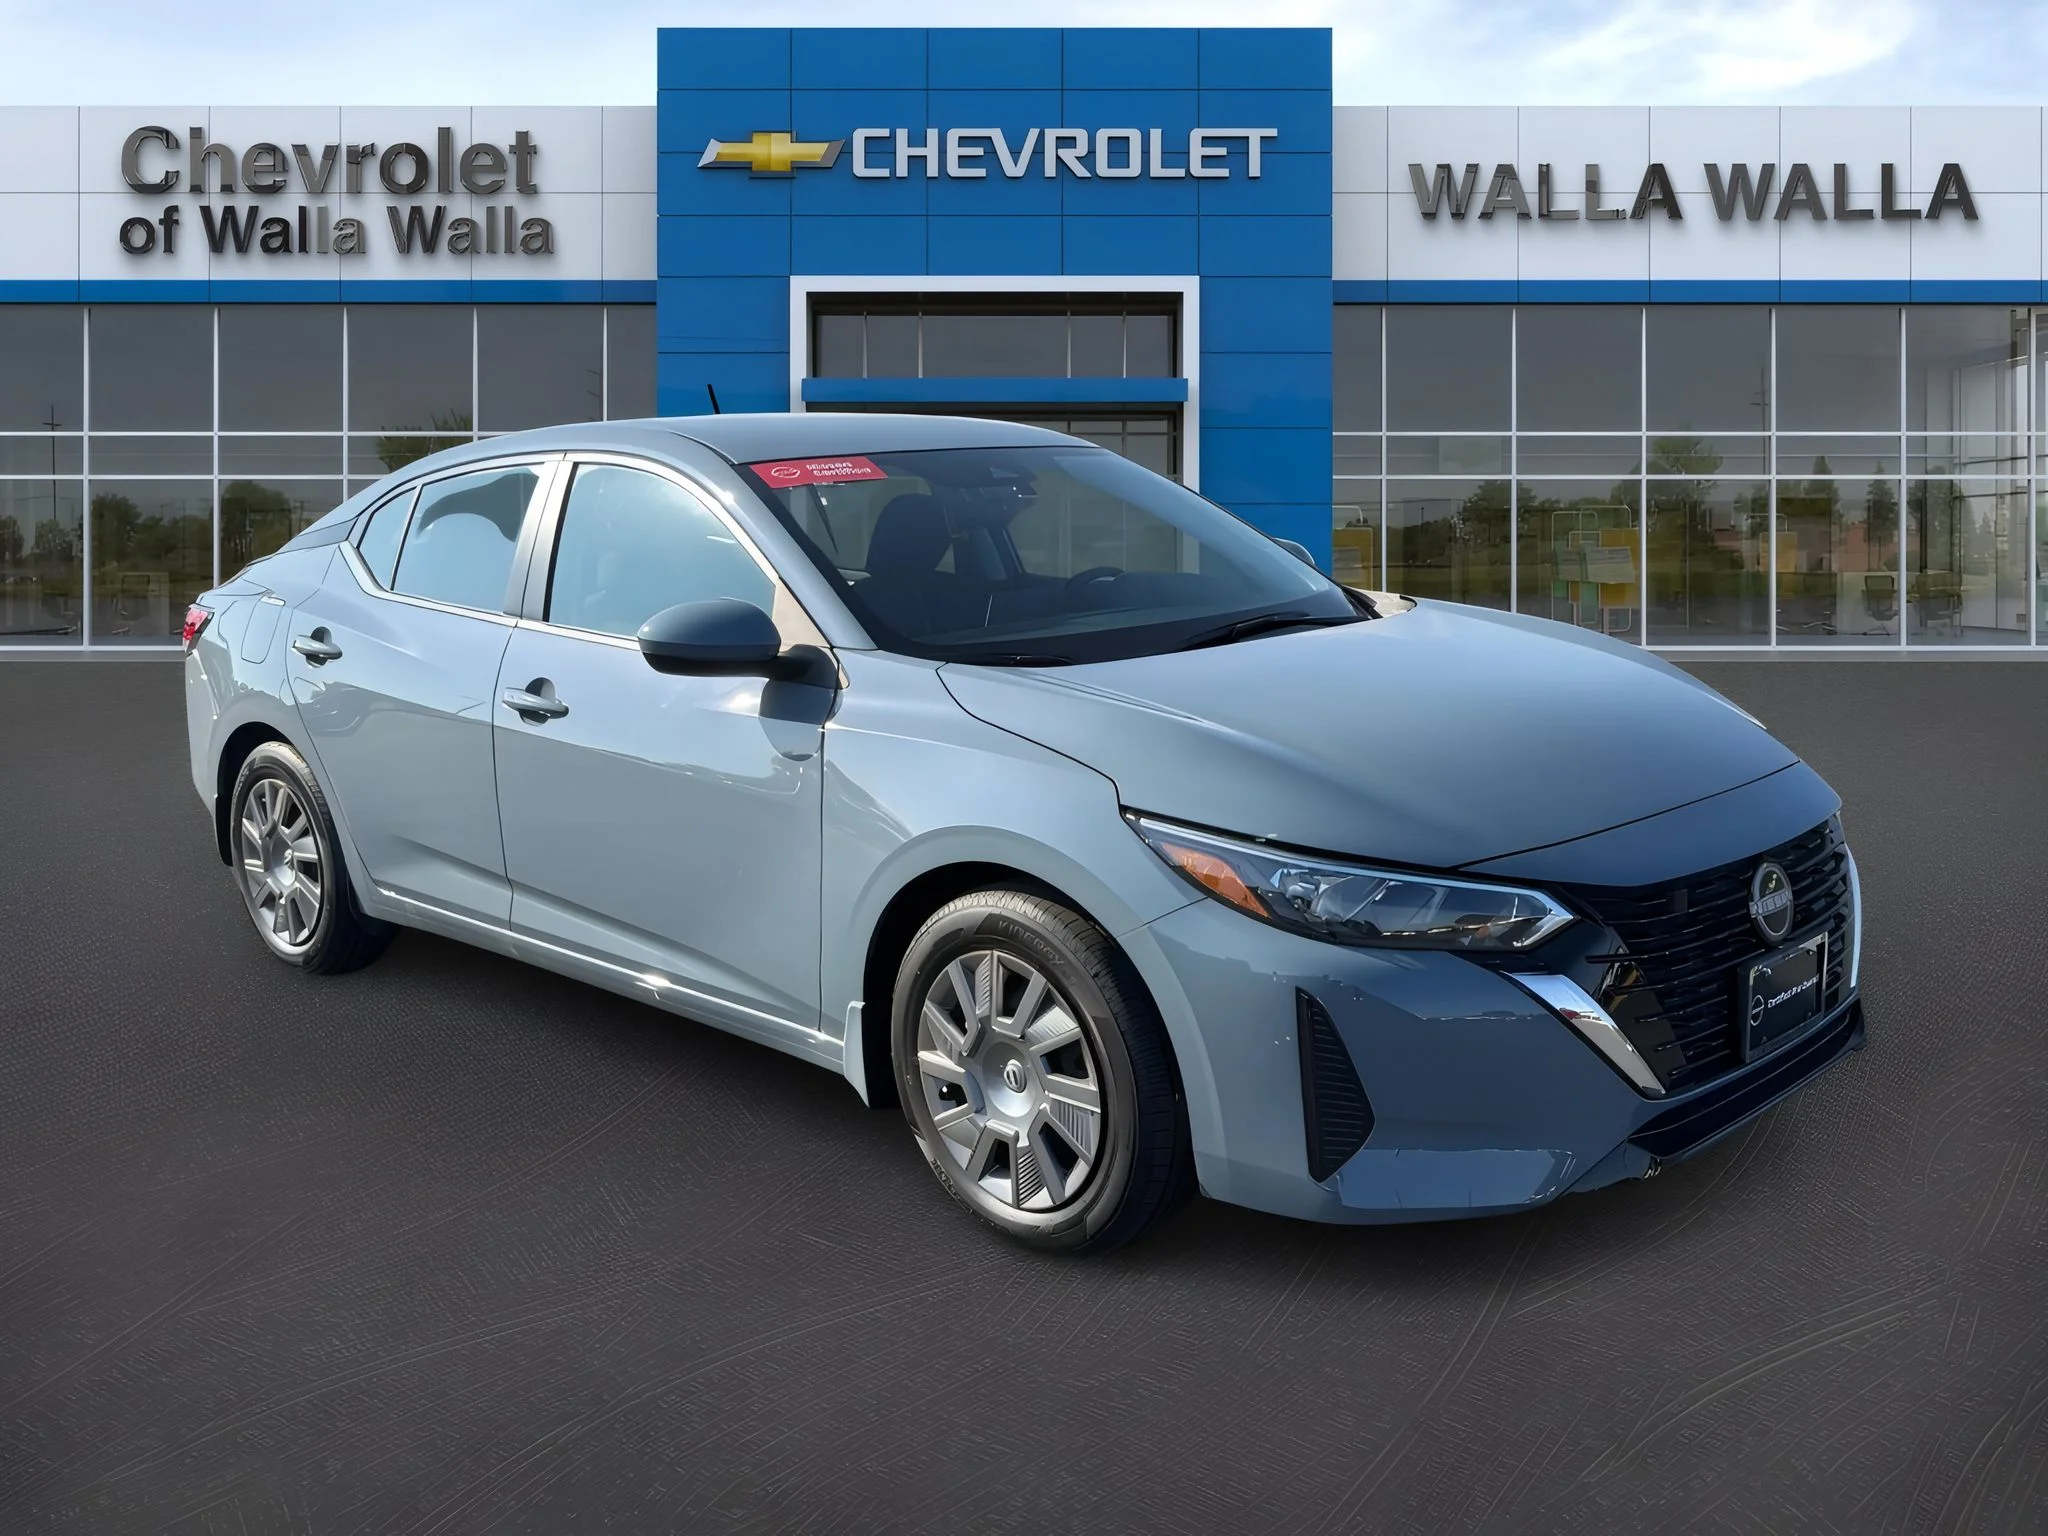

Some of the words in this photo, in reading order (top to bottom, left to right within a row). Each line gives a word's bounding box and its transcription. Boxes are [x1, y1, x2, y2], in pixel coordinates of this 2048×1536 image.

[121, 125, 537, 194] Chevrolet
[852, 128, 1278, 177] CHEVROLET
[1408, 163, 1683, 220] WALLA
[1703, 163, 1979, 220] WALLA
[119, 204, 180, 254] of
[200, 205, 366, 254] Walla
[387, 205, 553, 254] Walla
